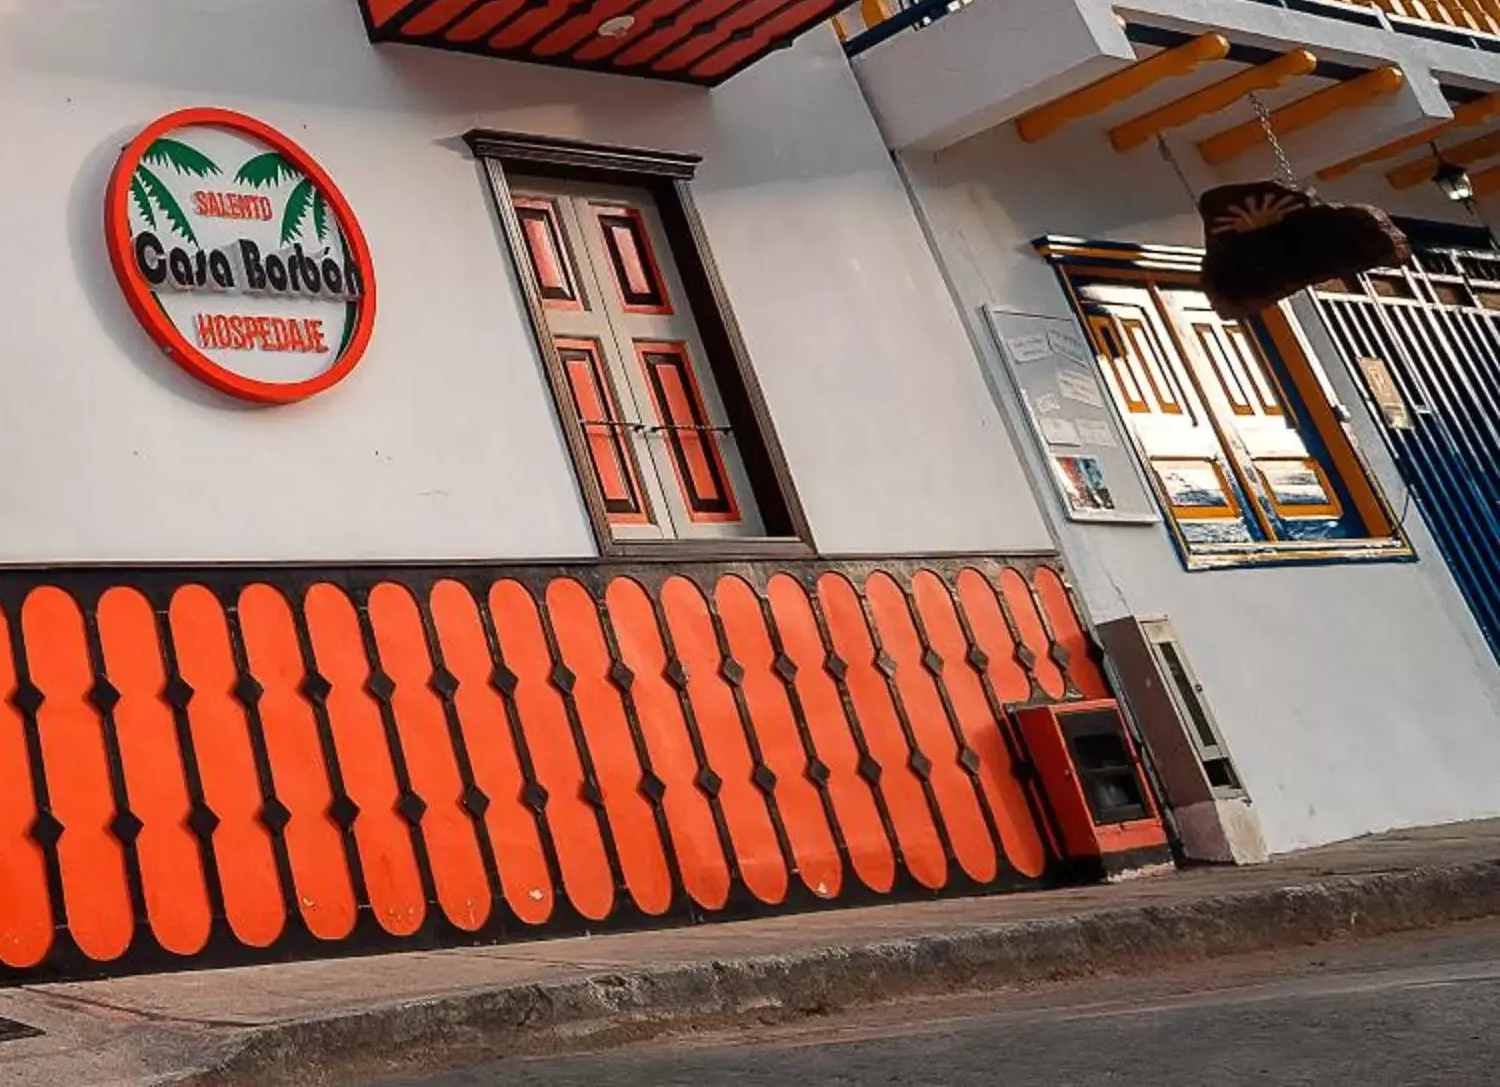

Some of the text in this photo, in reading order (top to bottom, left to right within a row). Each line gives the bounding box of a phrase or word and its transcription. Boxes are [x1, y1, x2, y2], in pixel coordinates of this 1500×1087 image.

[197, 191, 273, 220] SALENTO
[135, 231, 235, 287] Casa
[199, 313, 329, 353] HOSPEDAJE
